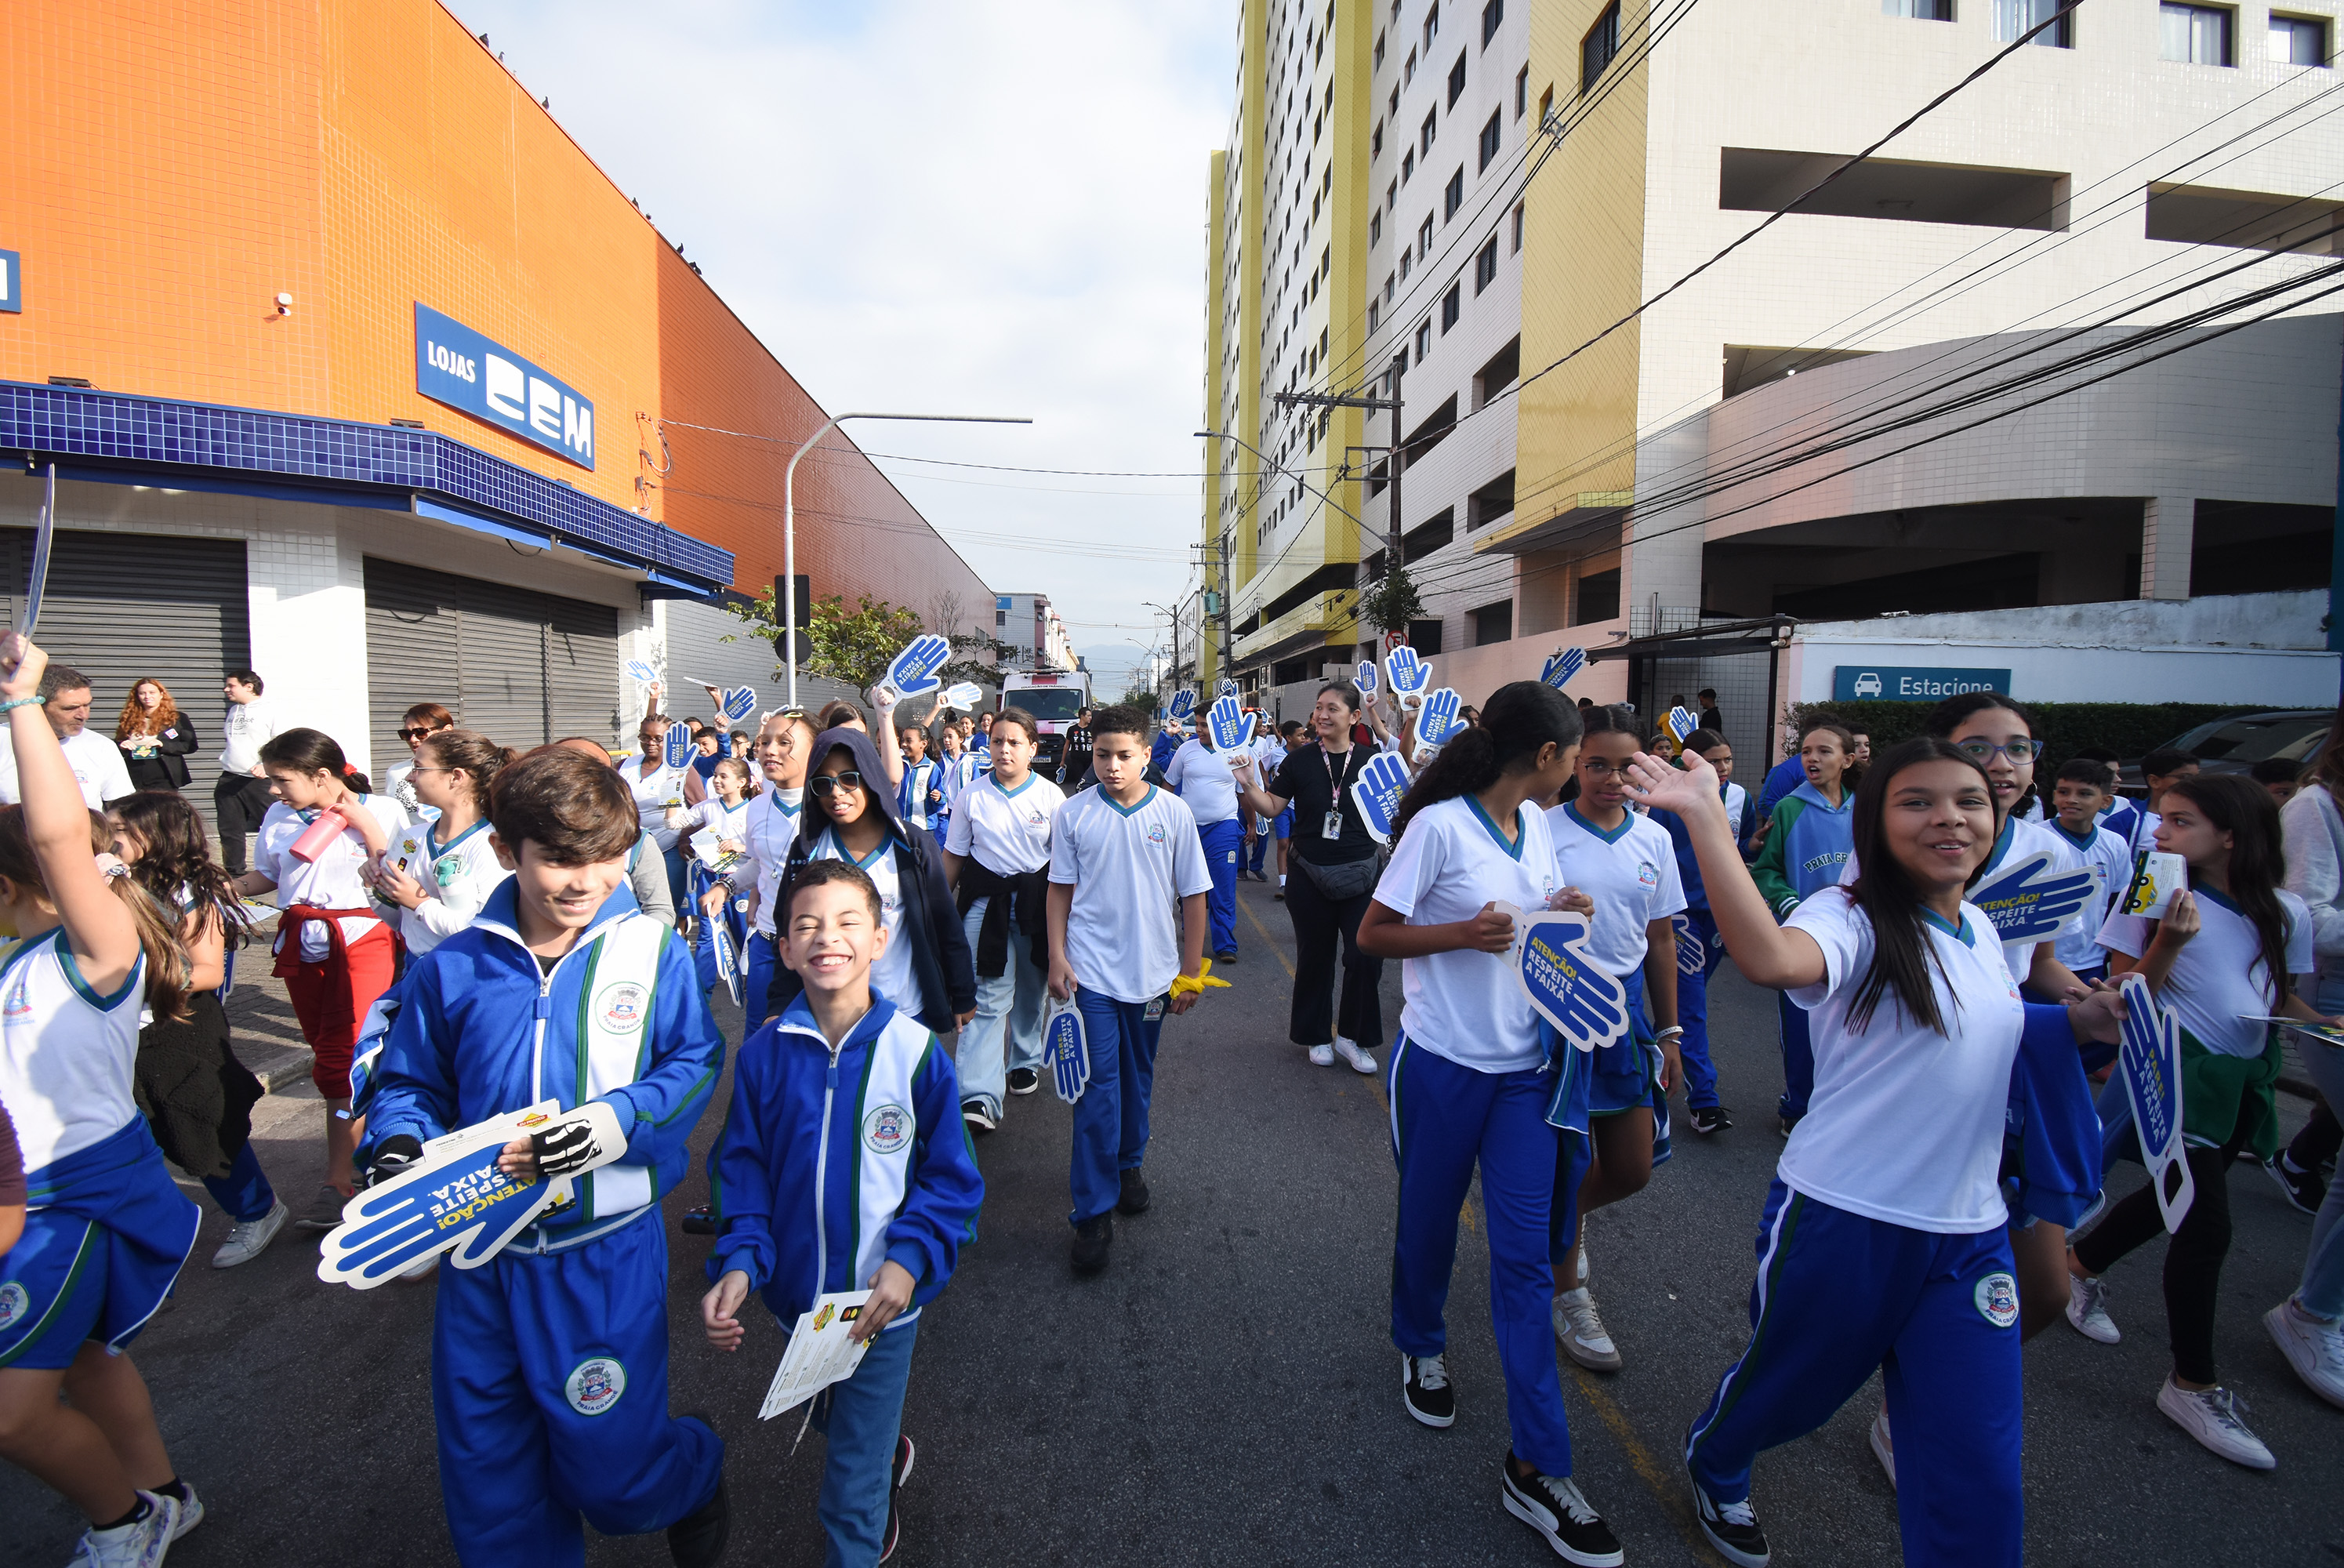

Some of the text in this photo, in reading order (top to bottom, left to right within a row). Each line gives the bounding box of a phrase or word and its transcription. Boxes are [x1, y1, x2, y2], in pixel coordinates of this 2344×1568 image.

[428, 340, 591, 458] LOJAS CEM
[898, 660, 923, 685] RESPEITE
[911, 664, 927, 681] PARE!
[1402, 667, 1413, 689] RESPEITE
[1900, 677, 1993, 695] Estacione
[1225, 721, 1235, 746] RESPEITE
[1431, 714, 1442, 742] RESPEITE
[1439, 716, 1448, 734] PARE!
[1380, 801, 1393, 825] FAIX
[1803, 853, 1834, 873] PRAIA
[1986, 905, 2037, 920] SPEITE
[1526, 961, 1533, 975] A
[1531, 937, 1577, 981] ATENÇÃO!
[1529, 949, 1573, 994] RESPEITE
[604, 1015, 640, 1029] PRAIA GRANDE
[1061, 1017, 1070, 1060] RESPEITE
[2139, 1070, 2145, 1085] A
[2149, 1047, 2165, 1101] PARE!
[2144, 1058, 2167, 1140] RESPEITE
[870, 1137, 903, 1149] PRAIA GRANDE
[437, 1177, 537, 1230] ATENÇÃO!
[1986, 1309, 2002, 1323] PRAIA
[577, 1391, 618, 1410] PRAIA GRANDE
